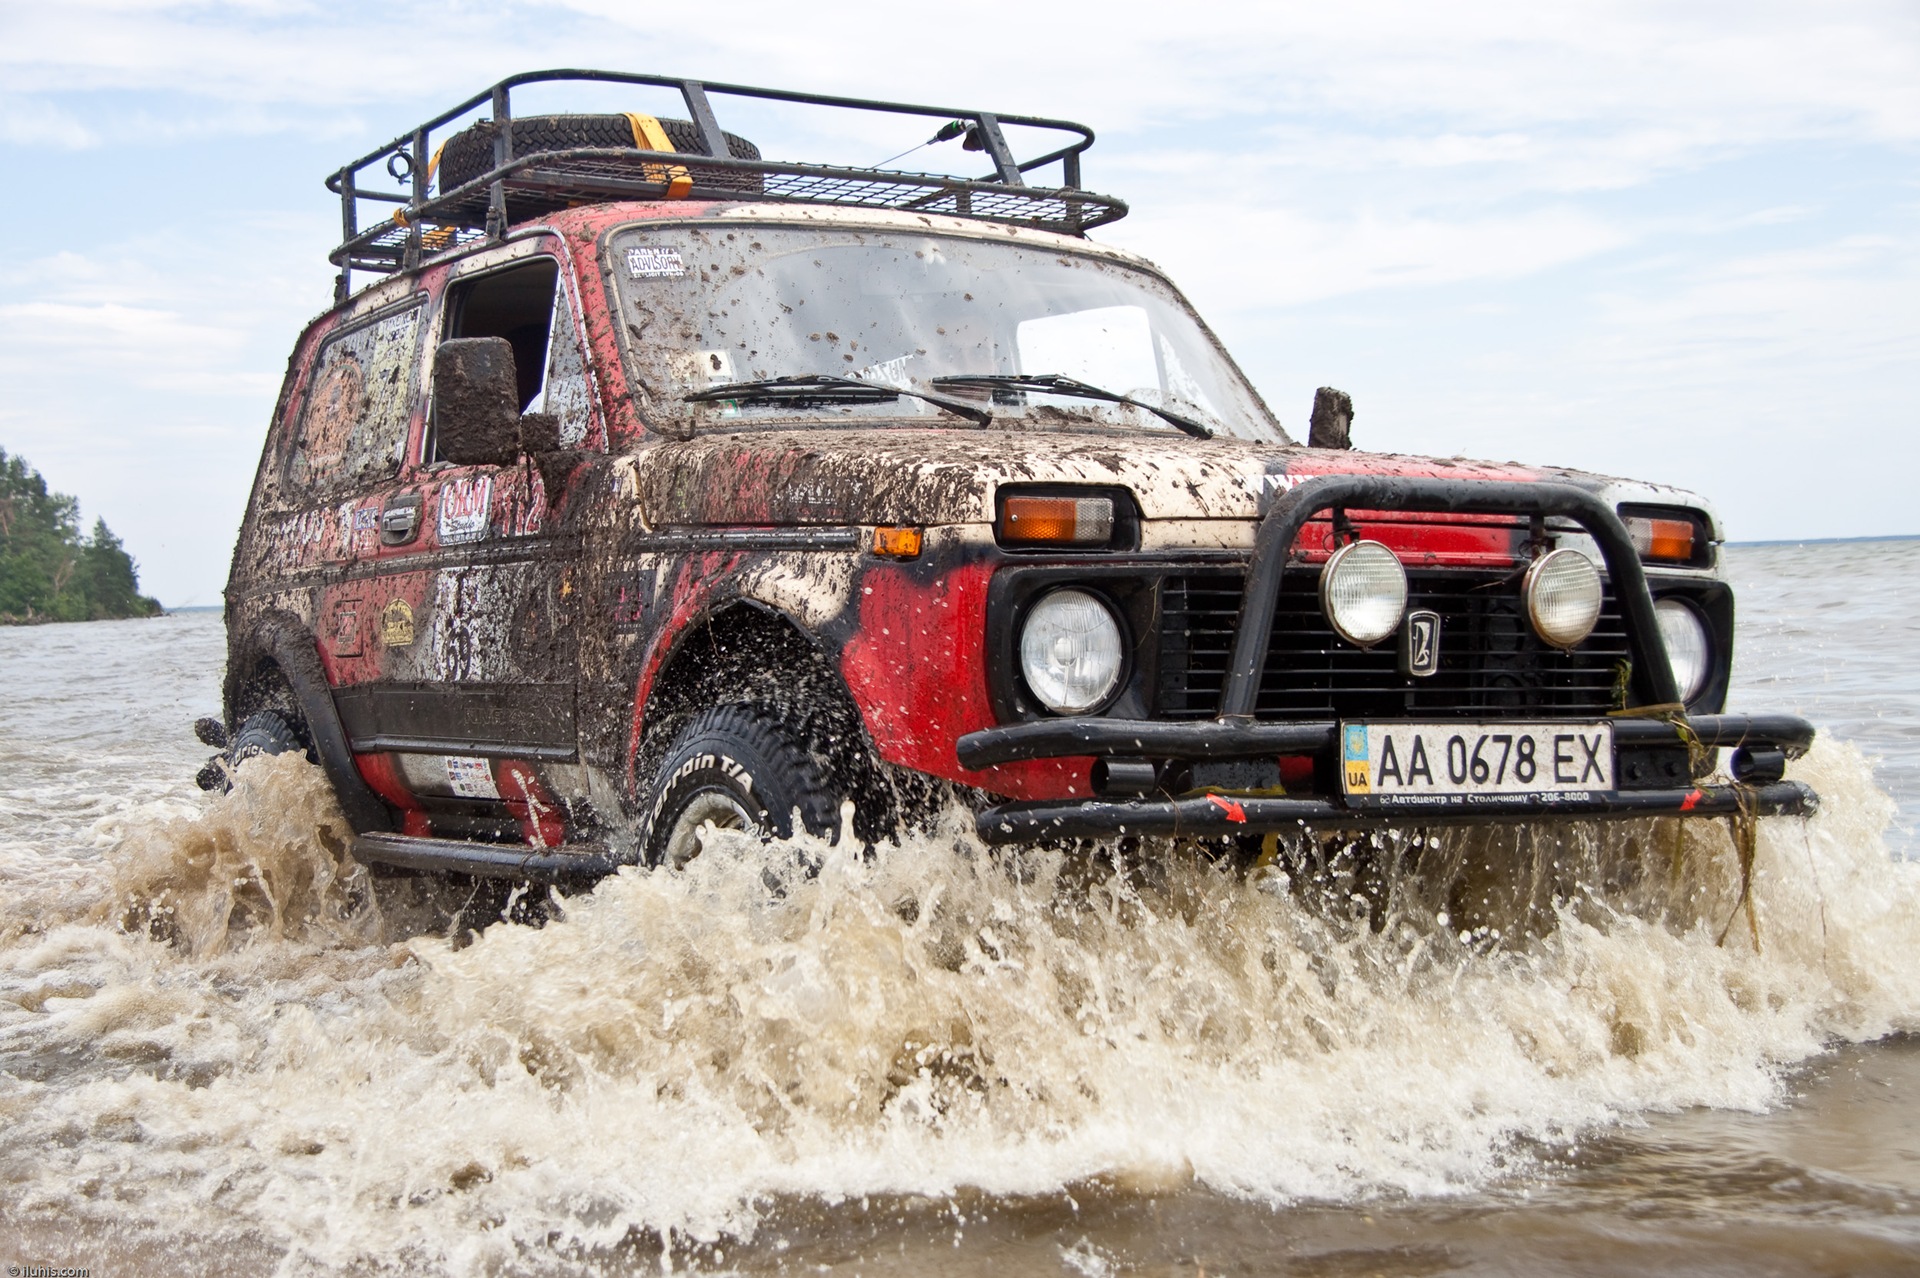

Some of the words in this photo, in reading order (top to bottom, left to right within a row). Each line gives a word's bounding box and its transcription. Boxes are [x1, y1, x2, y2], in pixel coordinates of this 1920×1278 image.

[721, 753, 753, 794] T/A
[1377, 735, 1434, 786] AA
[1447, 735, 1537, 784] 0678
[1554, 734, 1605, 783] EX
[1348, 772, 1368, 787] UA
[1467, 794, 1528, 804] Столичному
[1541, 793, 1590, 801] 206-8000
